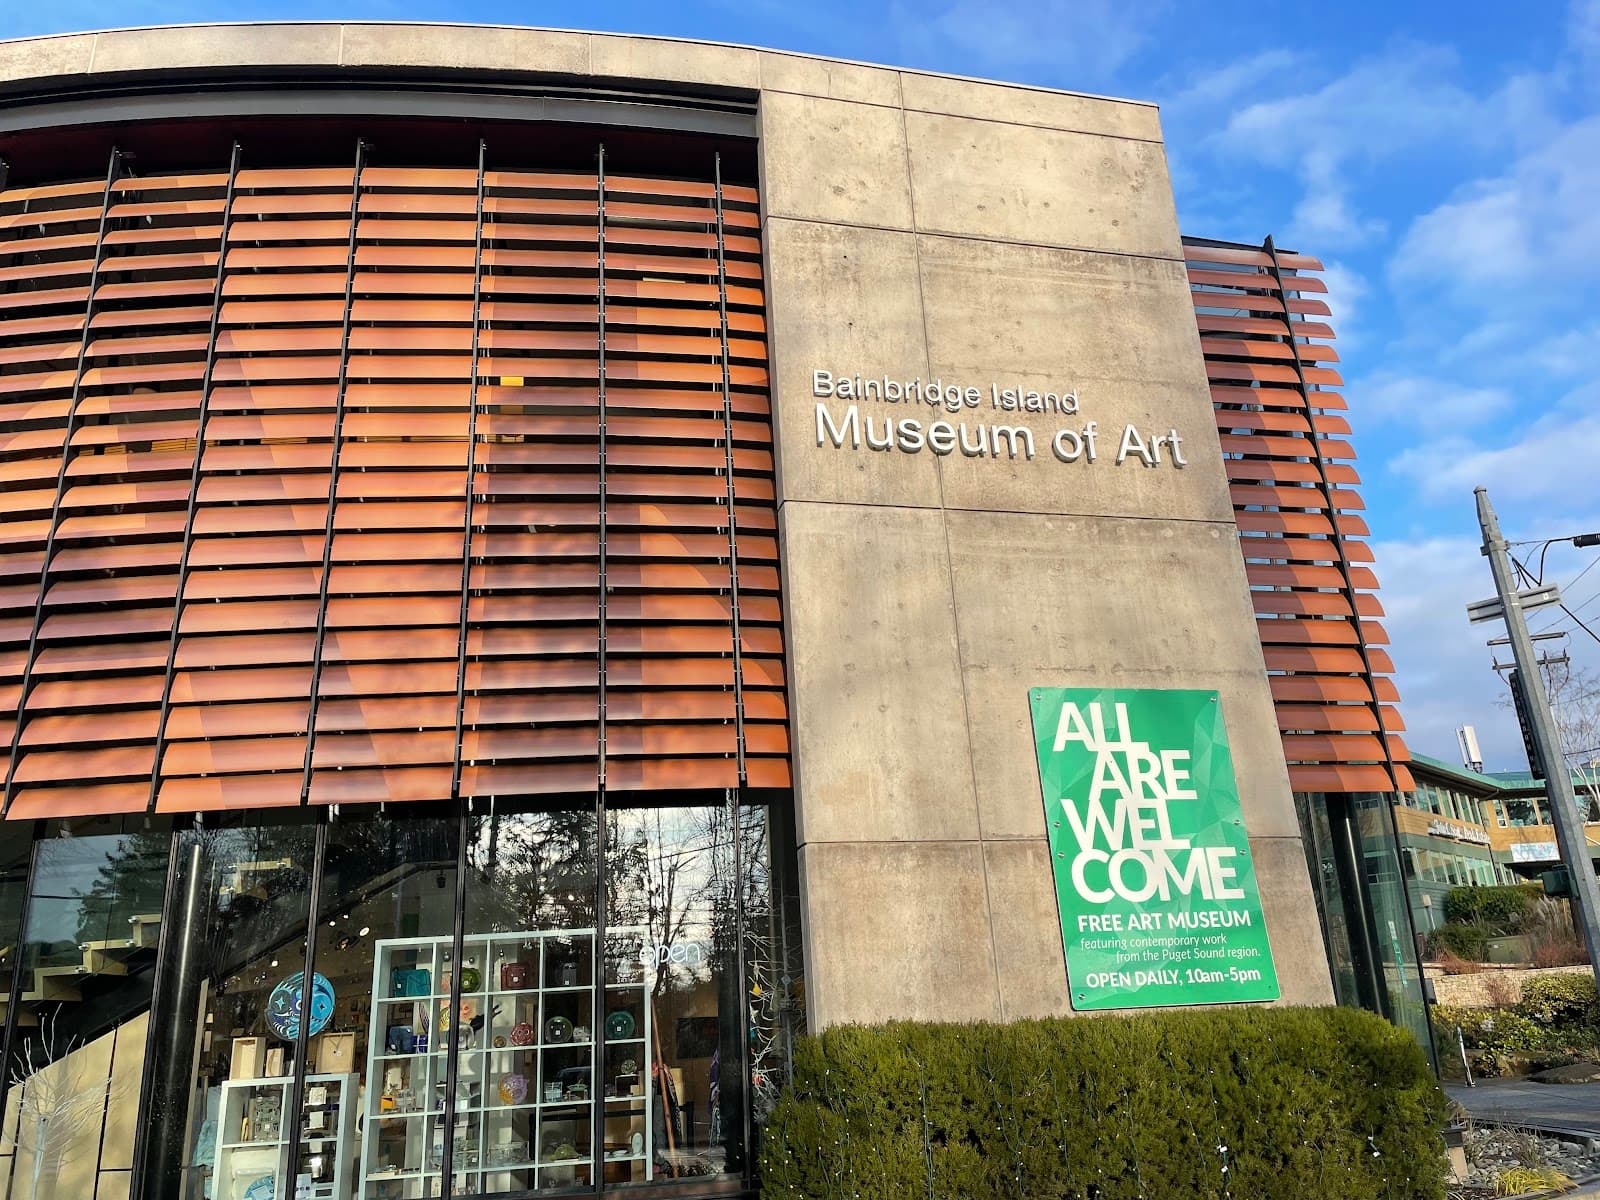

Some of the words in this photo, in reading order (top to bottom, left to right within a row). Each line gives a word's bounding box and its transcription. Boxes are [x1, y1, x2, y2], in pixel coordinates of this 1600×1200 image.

[813, 369, 982, 412] Bainbridge
[992, 383, 1079, 415] Island
[815, 402, 1036, 460] Museum
[1052, 421, 1097, 463] of
[1116, 424, 1188, 468] Art
[1053, 702, 1150, 751] ALL
[1088, 750, 1198, 800] ARE
[1060, 798, 1191, 850] WEL
[1071, 847, 1245, 903] COME
[1077, 914, 1123, 932] FREE
[1127, 913, 1162, 931] ART
[1167, 910, 1251, 929] MUSEUM
[1080, 937, 1127, 950] featuring
[1130, 934, 1200, 950] contemporary
[1202, 933, 1227, 945] work
[639, 943, 700, 969] open
[1086, 971, 1131, 988] OPEN
[1134, 969, 1183, 986] DAILY,
[1186, 967, 1261, 984] 10am-5pm
[1116, 951, 1140, 964] from
[1143, 950, 1159, 961] the
[1162, 949, 1191, 963] Puget
[1194, 947, 1225, 959] Sound
[1227, 947, 1261, 959] region.
